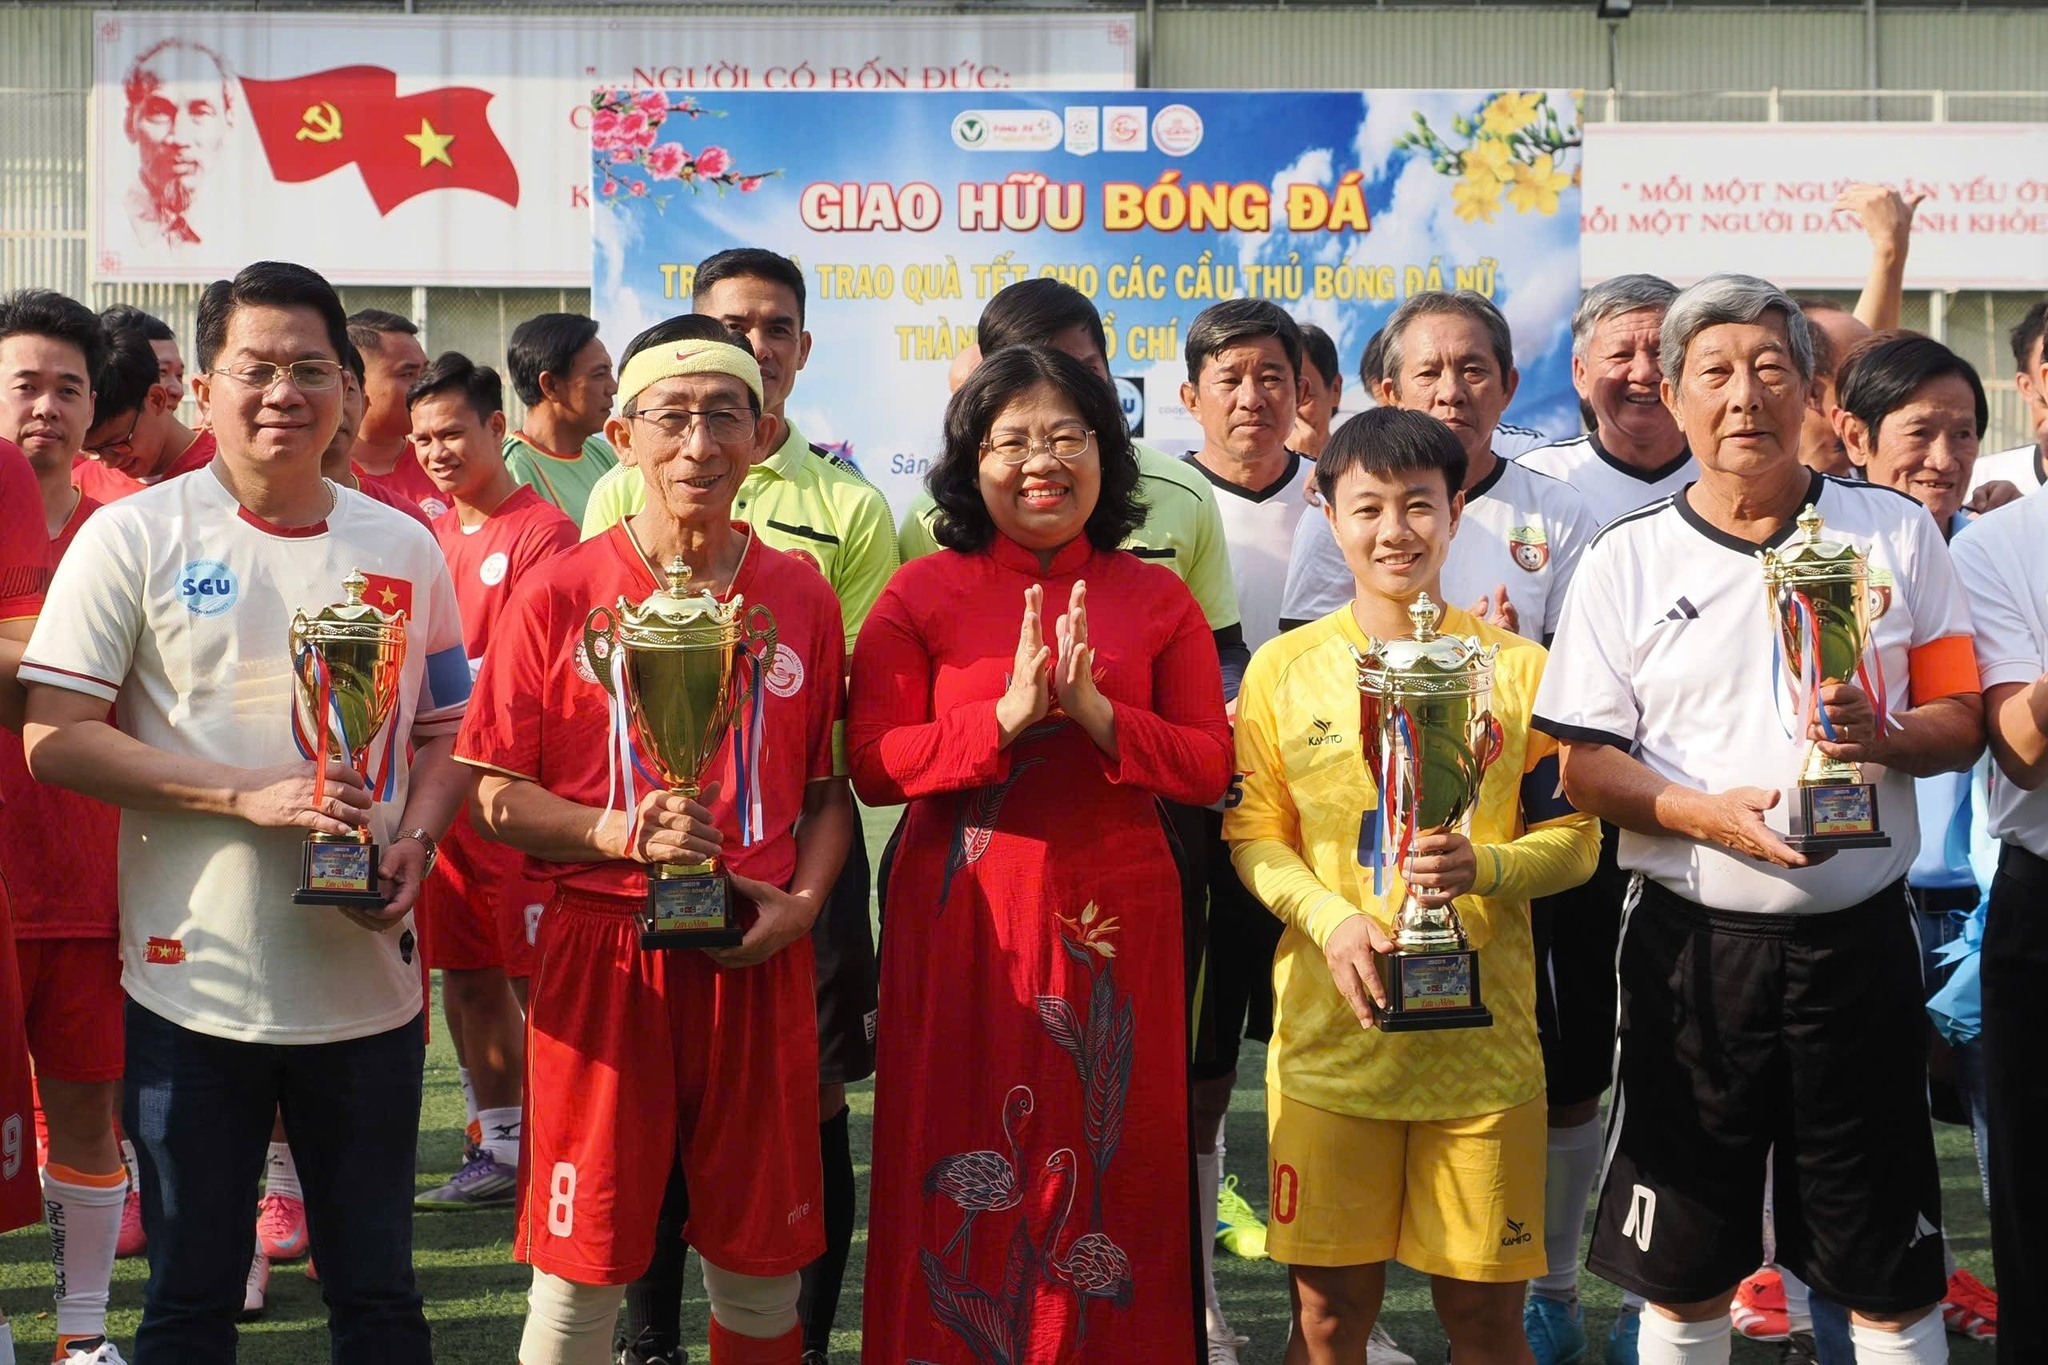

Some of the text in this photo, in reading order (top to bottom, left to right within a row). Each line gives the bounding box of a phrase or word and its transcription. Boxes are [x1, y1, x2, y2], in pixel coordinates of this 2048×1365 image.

[763, 61, 816, 88] CÓ
[830, 57, 909, 88] BỐN
[800, 169, 1371, 232] GIAO HỮU BÓNG ĐÁ
[1702, 177, 1766, 205] MỘT
[1580, 205, 1618, 233] ỖI
[1628, 208, 1691, 236] MỘT
[1702, 209, 1794, 233] NGƯỜI
[815, 263, 895, 300] TRAO
[902, 255, 962, 305] QUÀ
[1106, 255, 1167, 300] CÁC
[1174, 248, 1235, 301] CẦU
[1243, 251, 1304, 300] THỦ
[1313, 255, 1396, 300] BÓNG
[1403, 255, 1444, 300] ĐÁ
[1126, 316, 1179, 361] CHÍ
[182, 578, 230, 596] SGU
[1308, 734, 1342, 747] KAMITO
[2, 1113, 22, 1180] 9
[547, 1161, 577, 1238] 8
